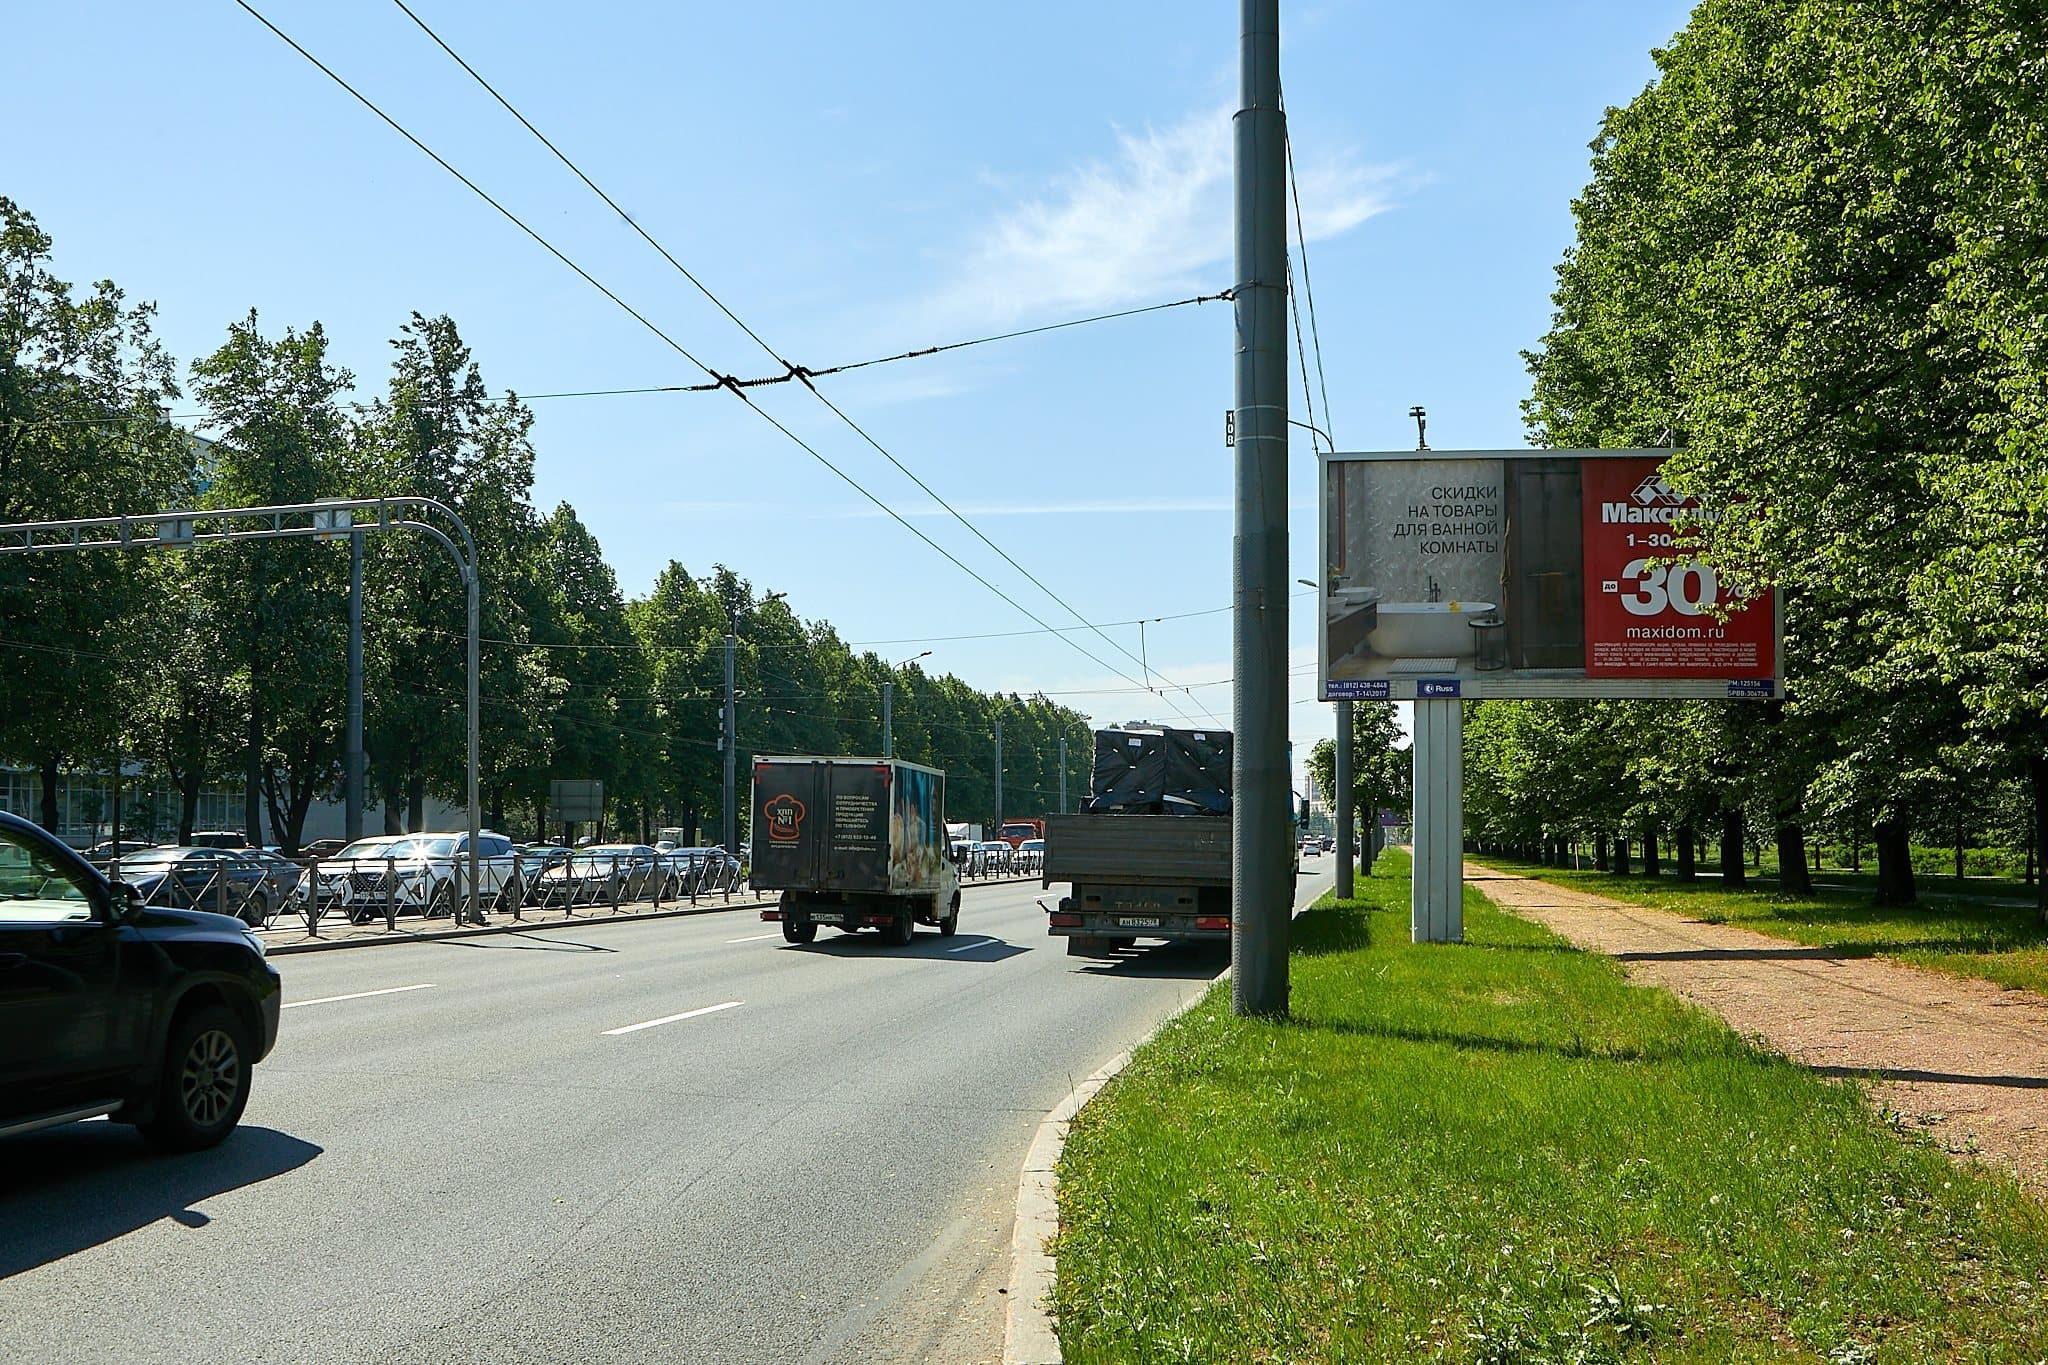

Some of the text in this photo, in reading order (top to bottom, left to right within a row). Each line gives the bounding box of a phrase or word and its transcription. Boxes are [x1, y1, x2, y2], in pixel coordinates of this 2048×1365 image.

[1431, 486, 1498, 501] СКИДКИ
[1408, 504, 1498, 518] НА ТОВАРЫ
[1393, 520, 1498, 539] ДЛЯ ВАННОЙ
[1419, 541, 1498, 554] КОМНАТЫ
[1604, 583, 1616, 591] до
[1626, 625, 1725, 639] maxidom.ru
[1435, 684, 1454, 693] Russ
